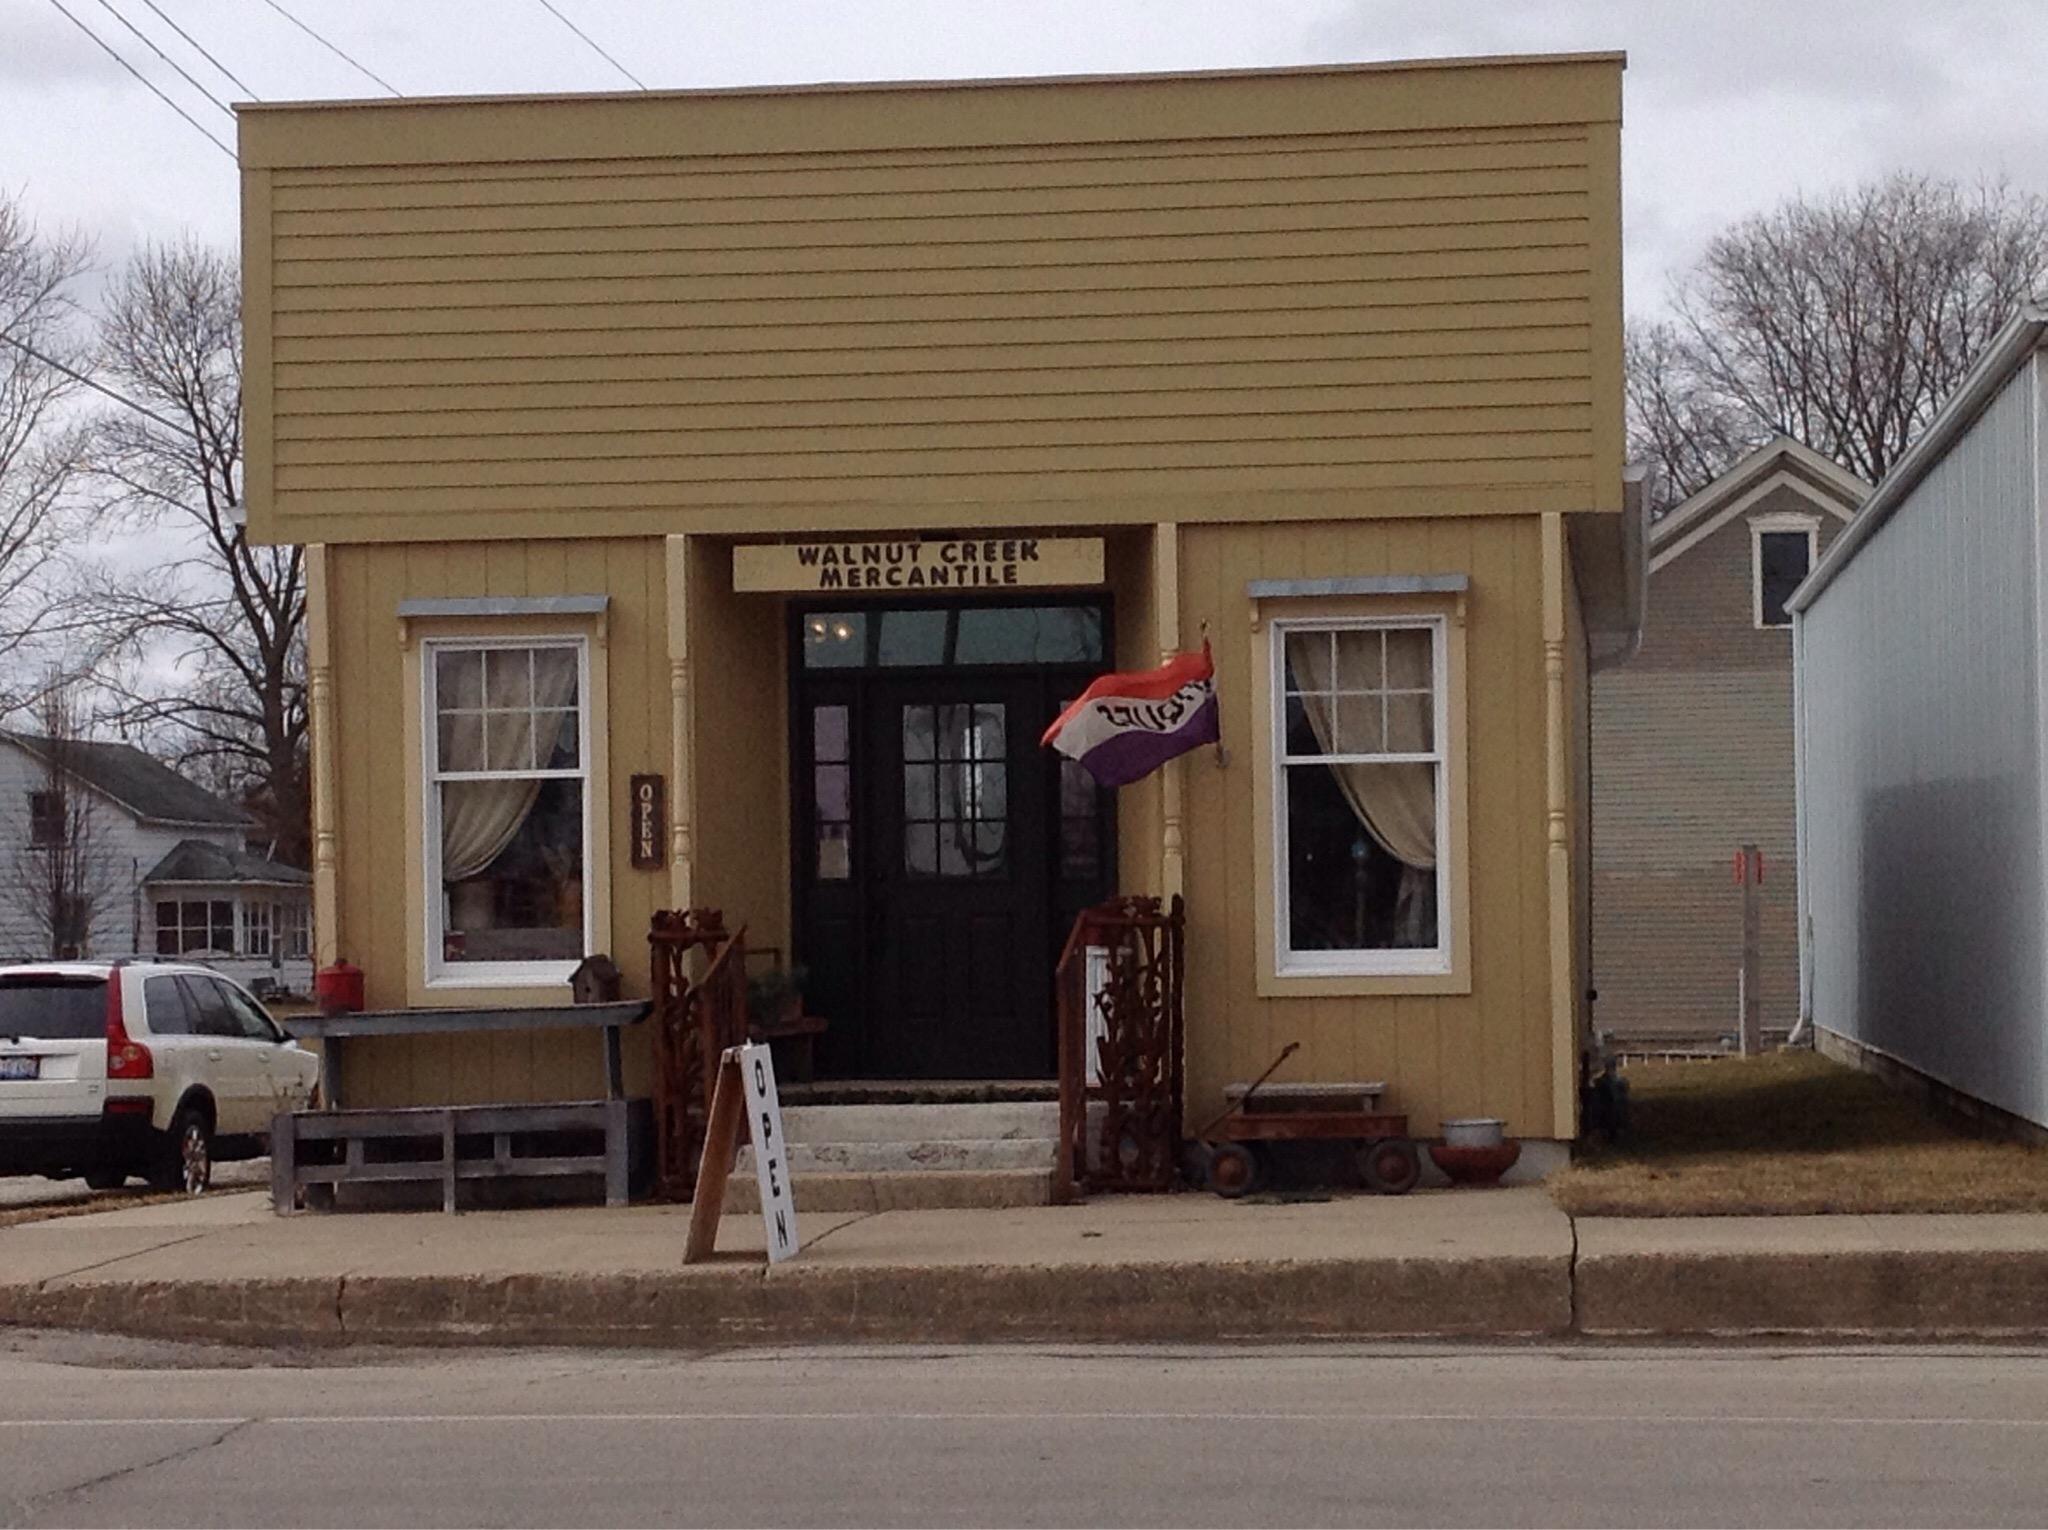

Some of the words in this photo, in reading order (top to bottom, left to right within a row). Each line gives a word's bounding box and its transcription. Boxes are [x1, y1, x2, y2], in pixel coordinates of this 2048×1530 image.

[797, 543, 922, 567] WALNUT
[940, 540, 1040, 564] CREEK
[818, 564, 1018, 588] MERCANTILE
[639, 783, 653, 858] OPEN
[754, 1058, 788, 1249] OPEN
